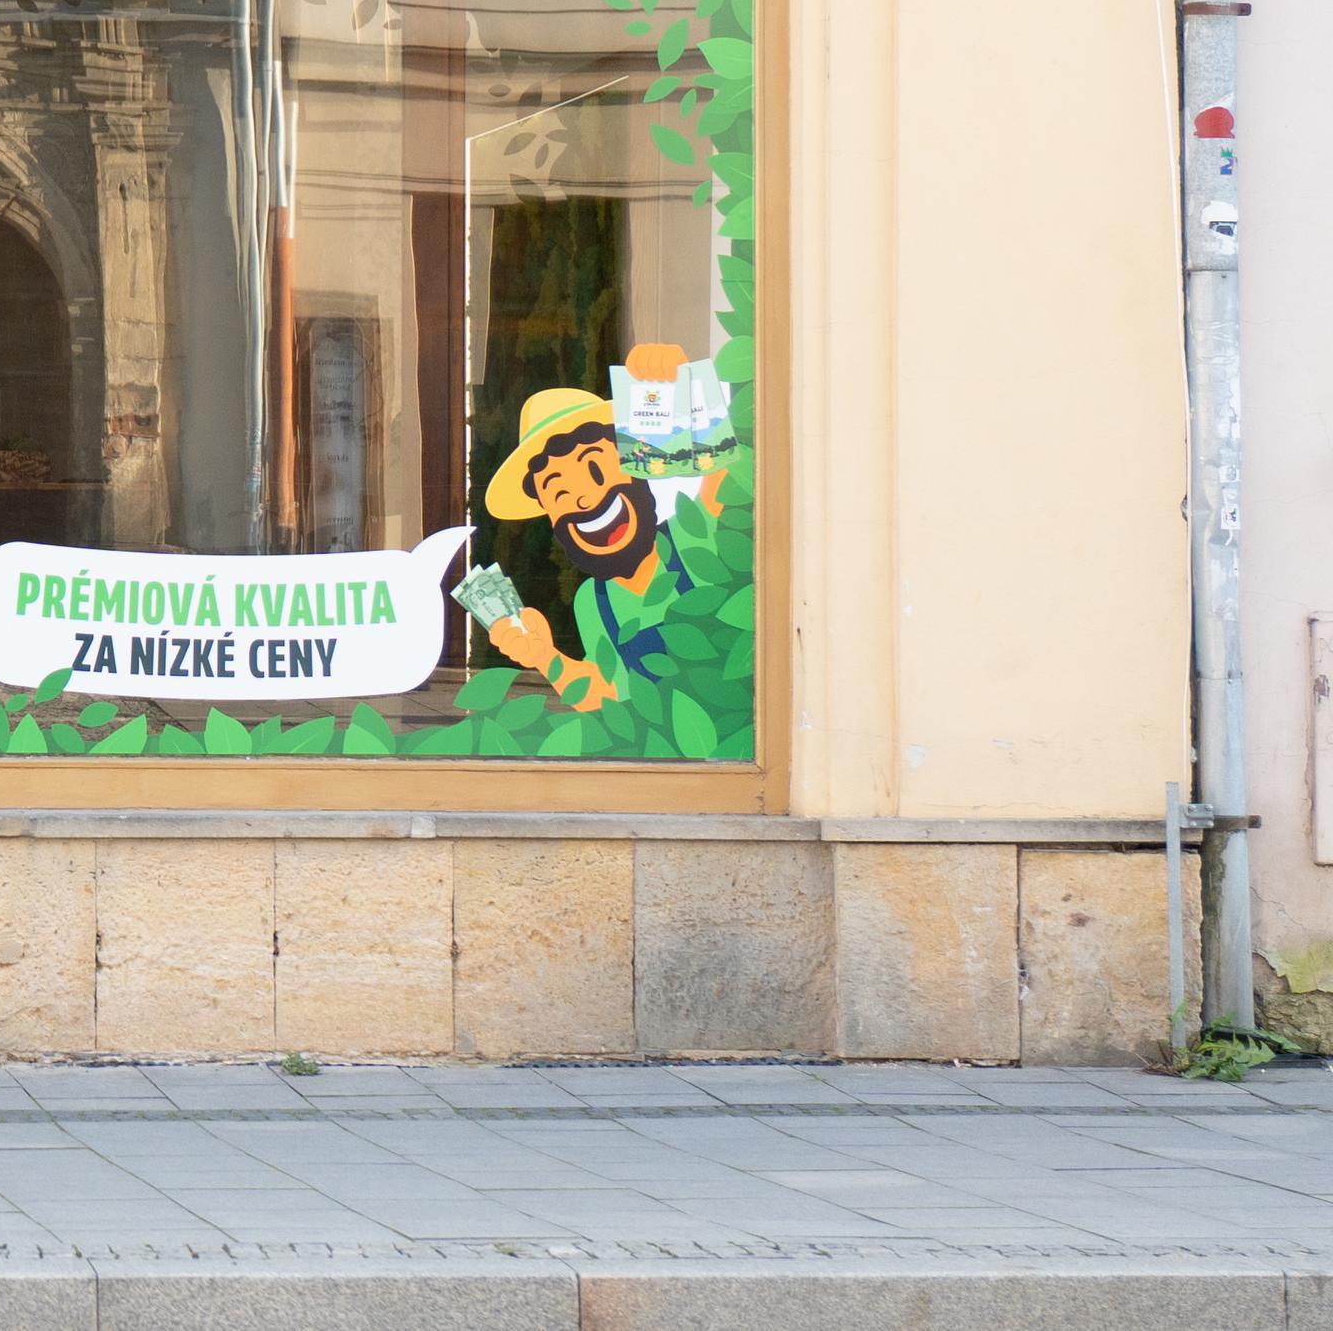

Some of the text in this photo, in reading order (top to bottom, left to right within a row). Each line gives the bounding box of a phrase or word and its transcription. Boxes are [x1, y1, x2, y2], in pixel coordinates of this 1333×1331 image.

[16, 569, 397, 627] PRÉMIOVÁ KVALITA
[72, 630, 337, 679] ZA NÍZKÉ CENY
